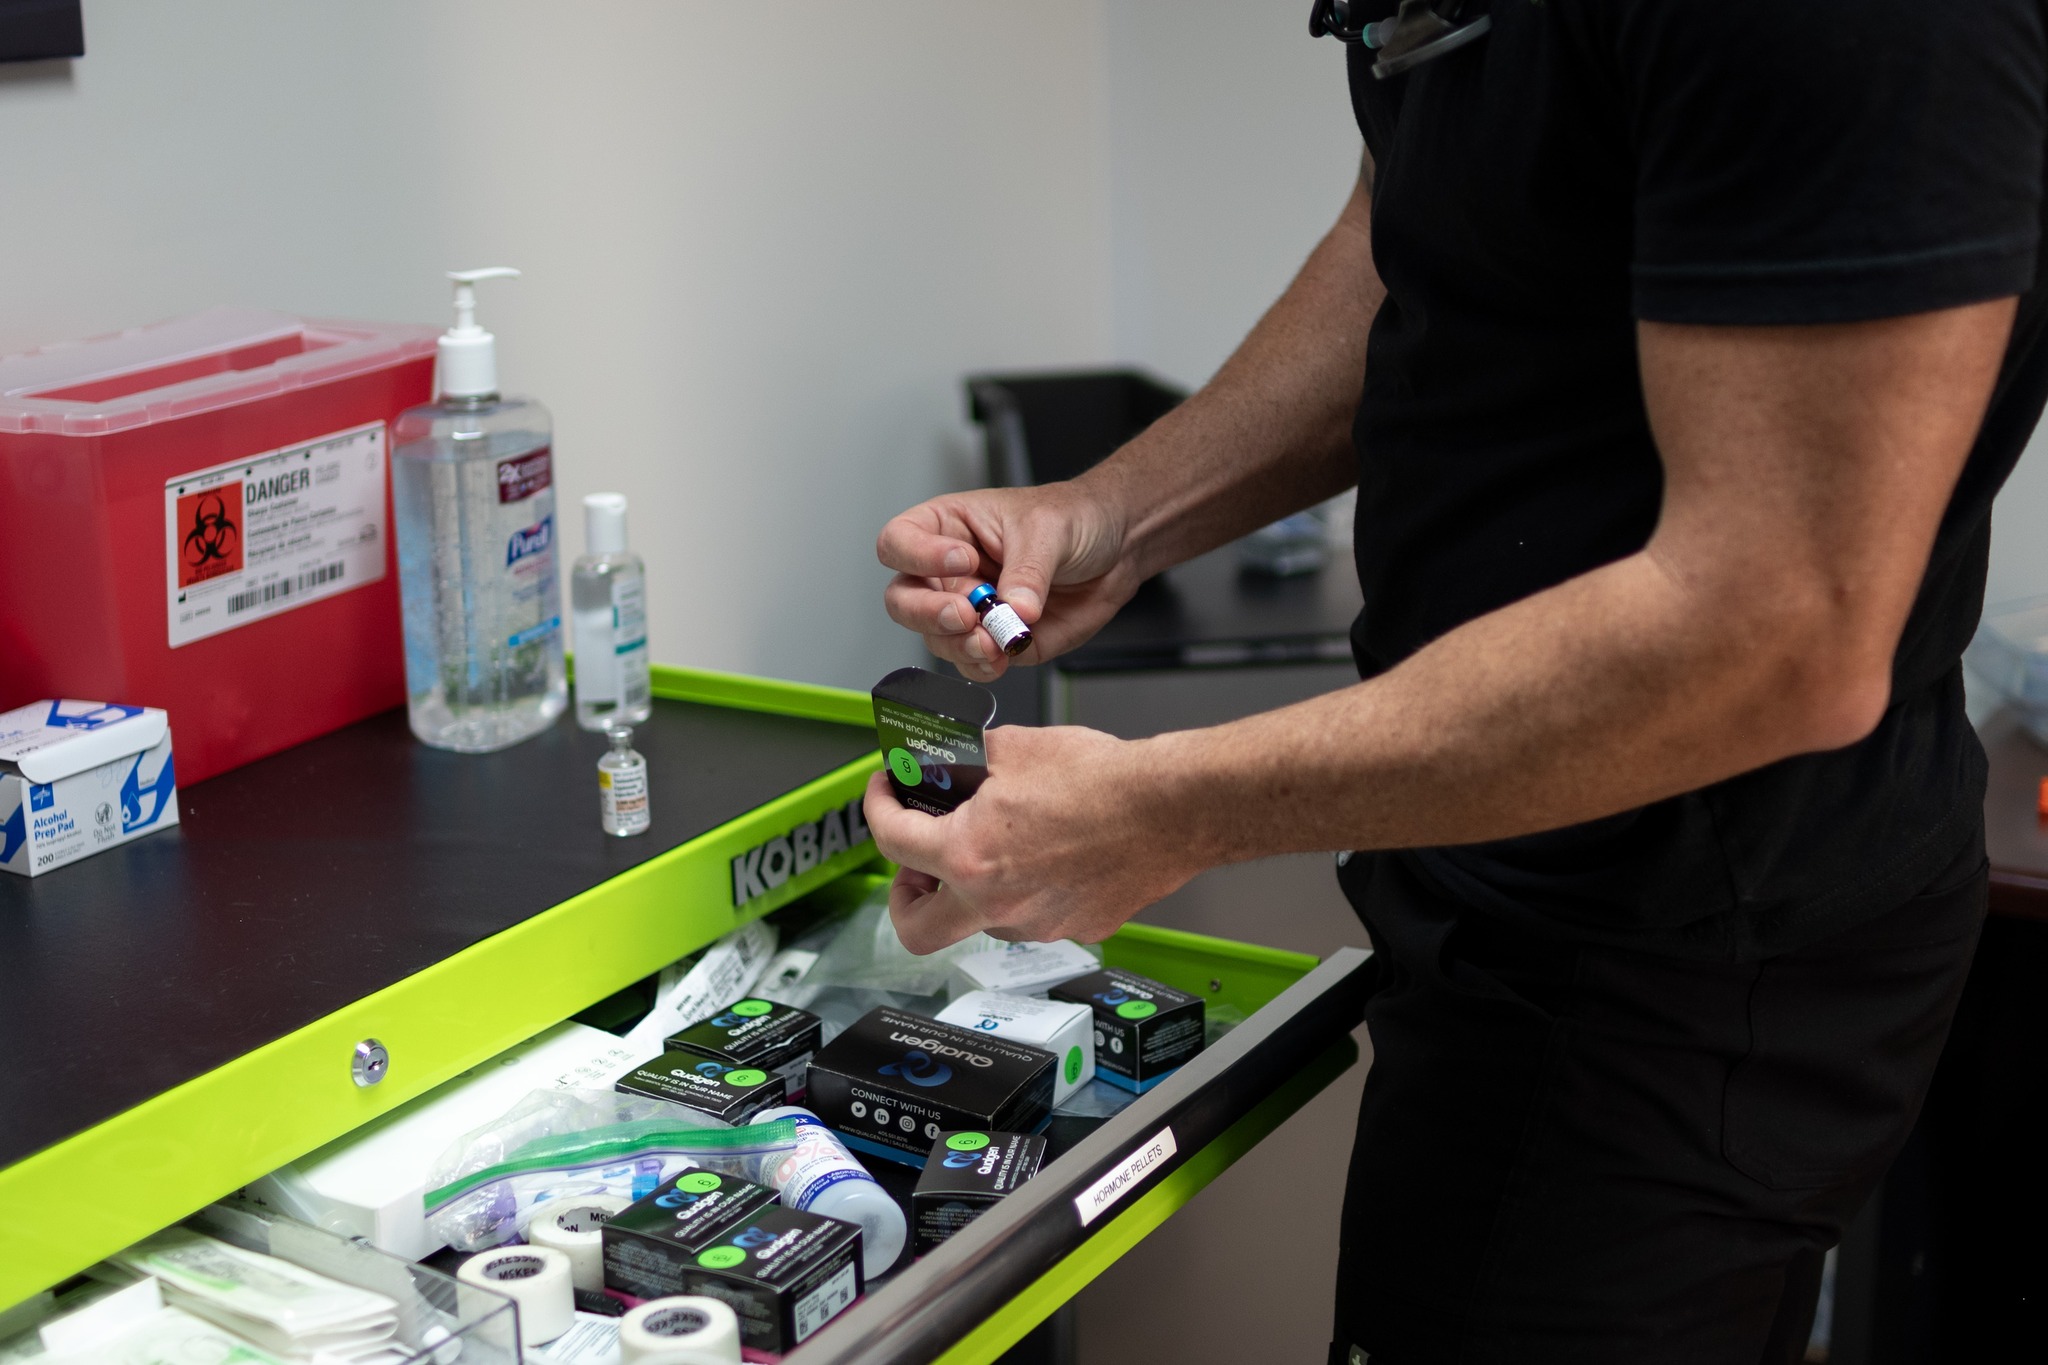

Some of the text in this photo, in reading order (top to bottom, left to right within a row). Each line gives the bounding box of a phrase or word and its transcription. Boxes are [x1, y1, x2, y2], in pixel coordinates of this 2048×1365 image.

[246, 467, 311, 504] DANGER
[880, 714, 979, 754] QUALITY IS IN OUR NAME
[906, 737, 956, 763] Qualgen
[34, 809, 68, 830] Alcohol
[34, 818, 75, 841] Prep Pad
[93, 828, 103, 840] Do
[37, 853, 54, 867] 200
[732, 799, 869, 906] KOBAL
[723, 1034, 752, 1050] QUALITY
[764, 1019, 781, 1030] OUR
[727, 1015, 771, 1036] Qualgen
[881, 1016, 918, 1030] NAME
[919, 1026, 948, 1038] OUR
[1095, 1019, 1125, 1037] WITH US
[890, 1031, 992, 1067] Qualgen
[979, 1038, 1032, 1062] QUALITY
[636, 1069, 671, 1081] QUALITY
[688, 1084, 708, 1092] OUR
[707, 1089, 733, 1100] NAME
[670, 1068, 720, 1087] Qualgen
[851, 1087, 941, 1121] CONNECT WITH US
[977, 1146, 1000, 1174] Qualgen
[993, 1168, 1007, 1190] QUALITY
[1093, 1144, 1163, 1206] HORMONE PELLETS
[802, 1178, 825, 1200] Hydrox
[676, 1191, 723, 1220] Qualgen
[674, 1216, 704, 1237] QUALITY
